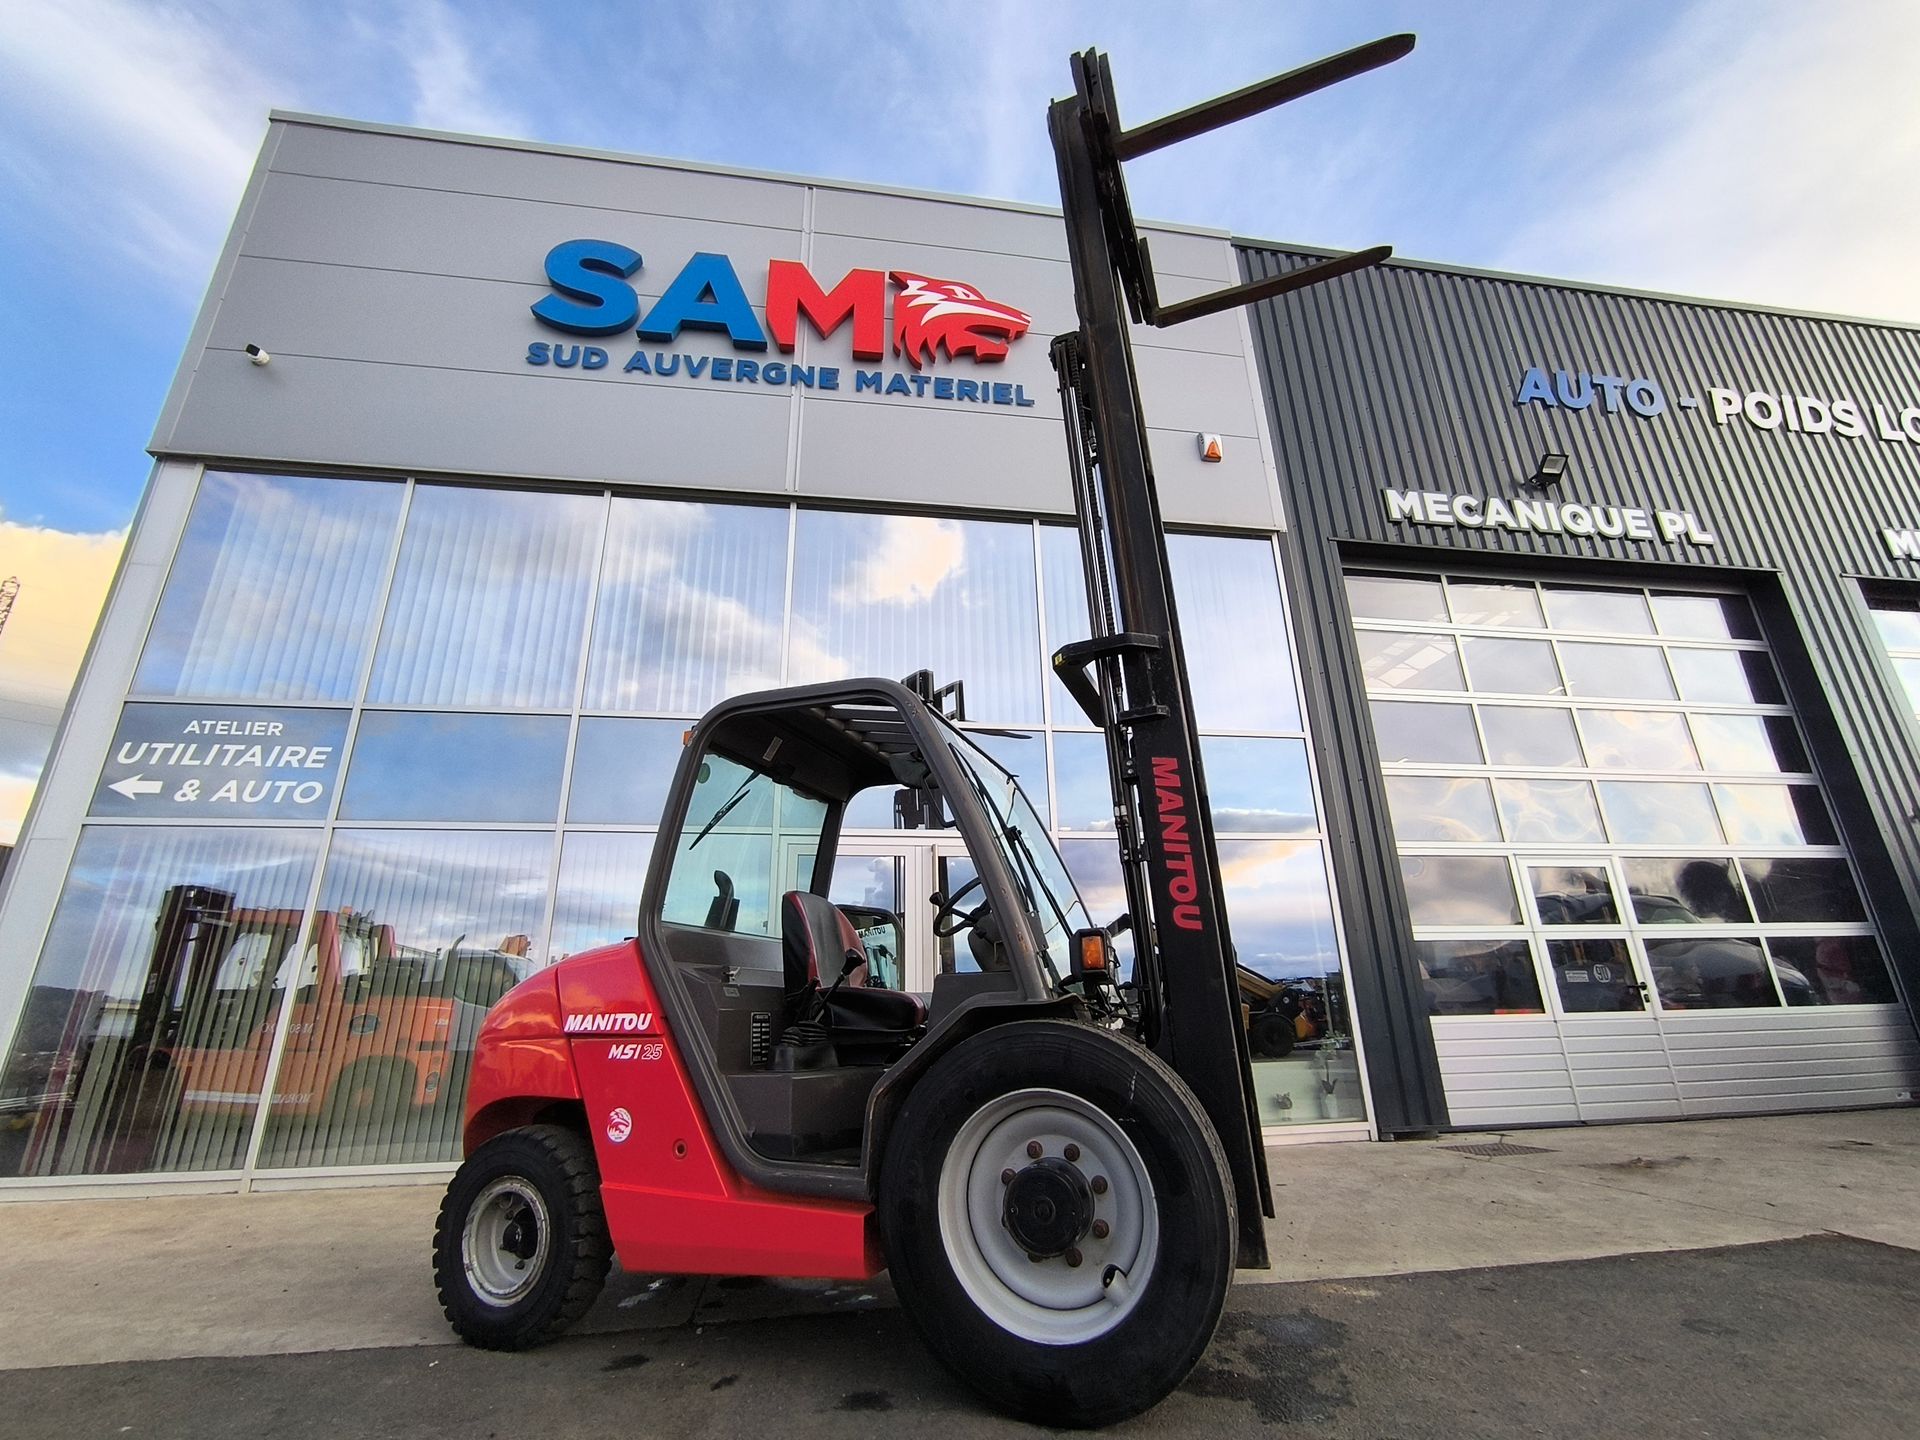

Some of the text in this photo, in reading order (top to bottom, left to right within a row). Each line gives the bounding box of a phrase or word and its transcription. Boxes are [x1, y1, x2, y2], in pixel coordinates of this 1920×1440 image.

[530, 239, 889, 361] SAM
[525, 342, 1035, 407] SUD AUVERGNE MATERIEL
[1517, 367, 1666, 418] AUTO
[1708, 386, 1866, 438] POIDS
[1384, 488, 1714, 545] MECANIQUE PL
[183, 720, 284, 736] ATELIER
[117, 742, 333, 768] UTILITAIRE
[173, 779, 324, 804] & AUTO
[1152, 757, 1204, 930] MANITOU
[564, 1013, 652, 1033] MANITOU
[608, 1044, 663, 1060] MSI 25
